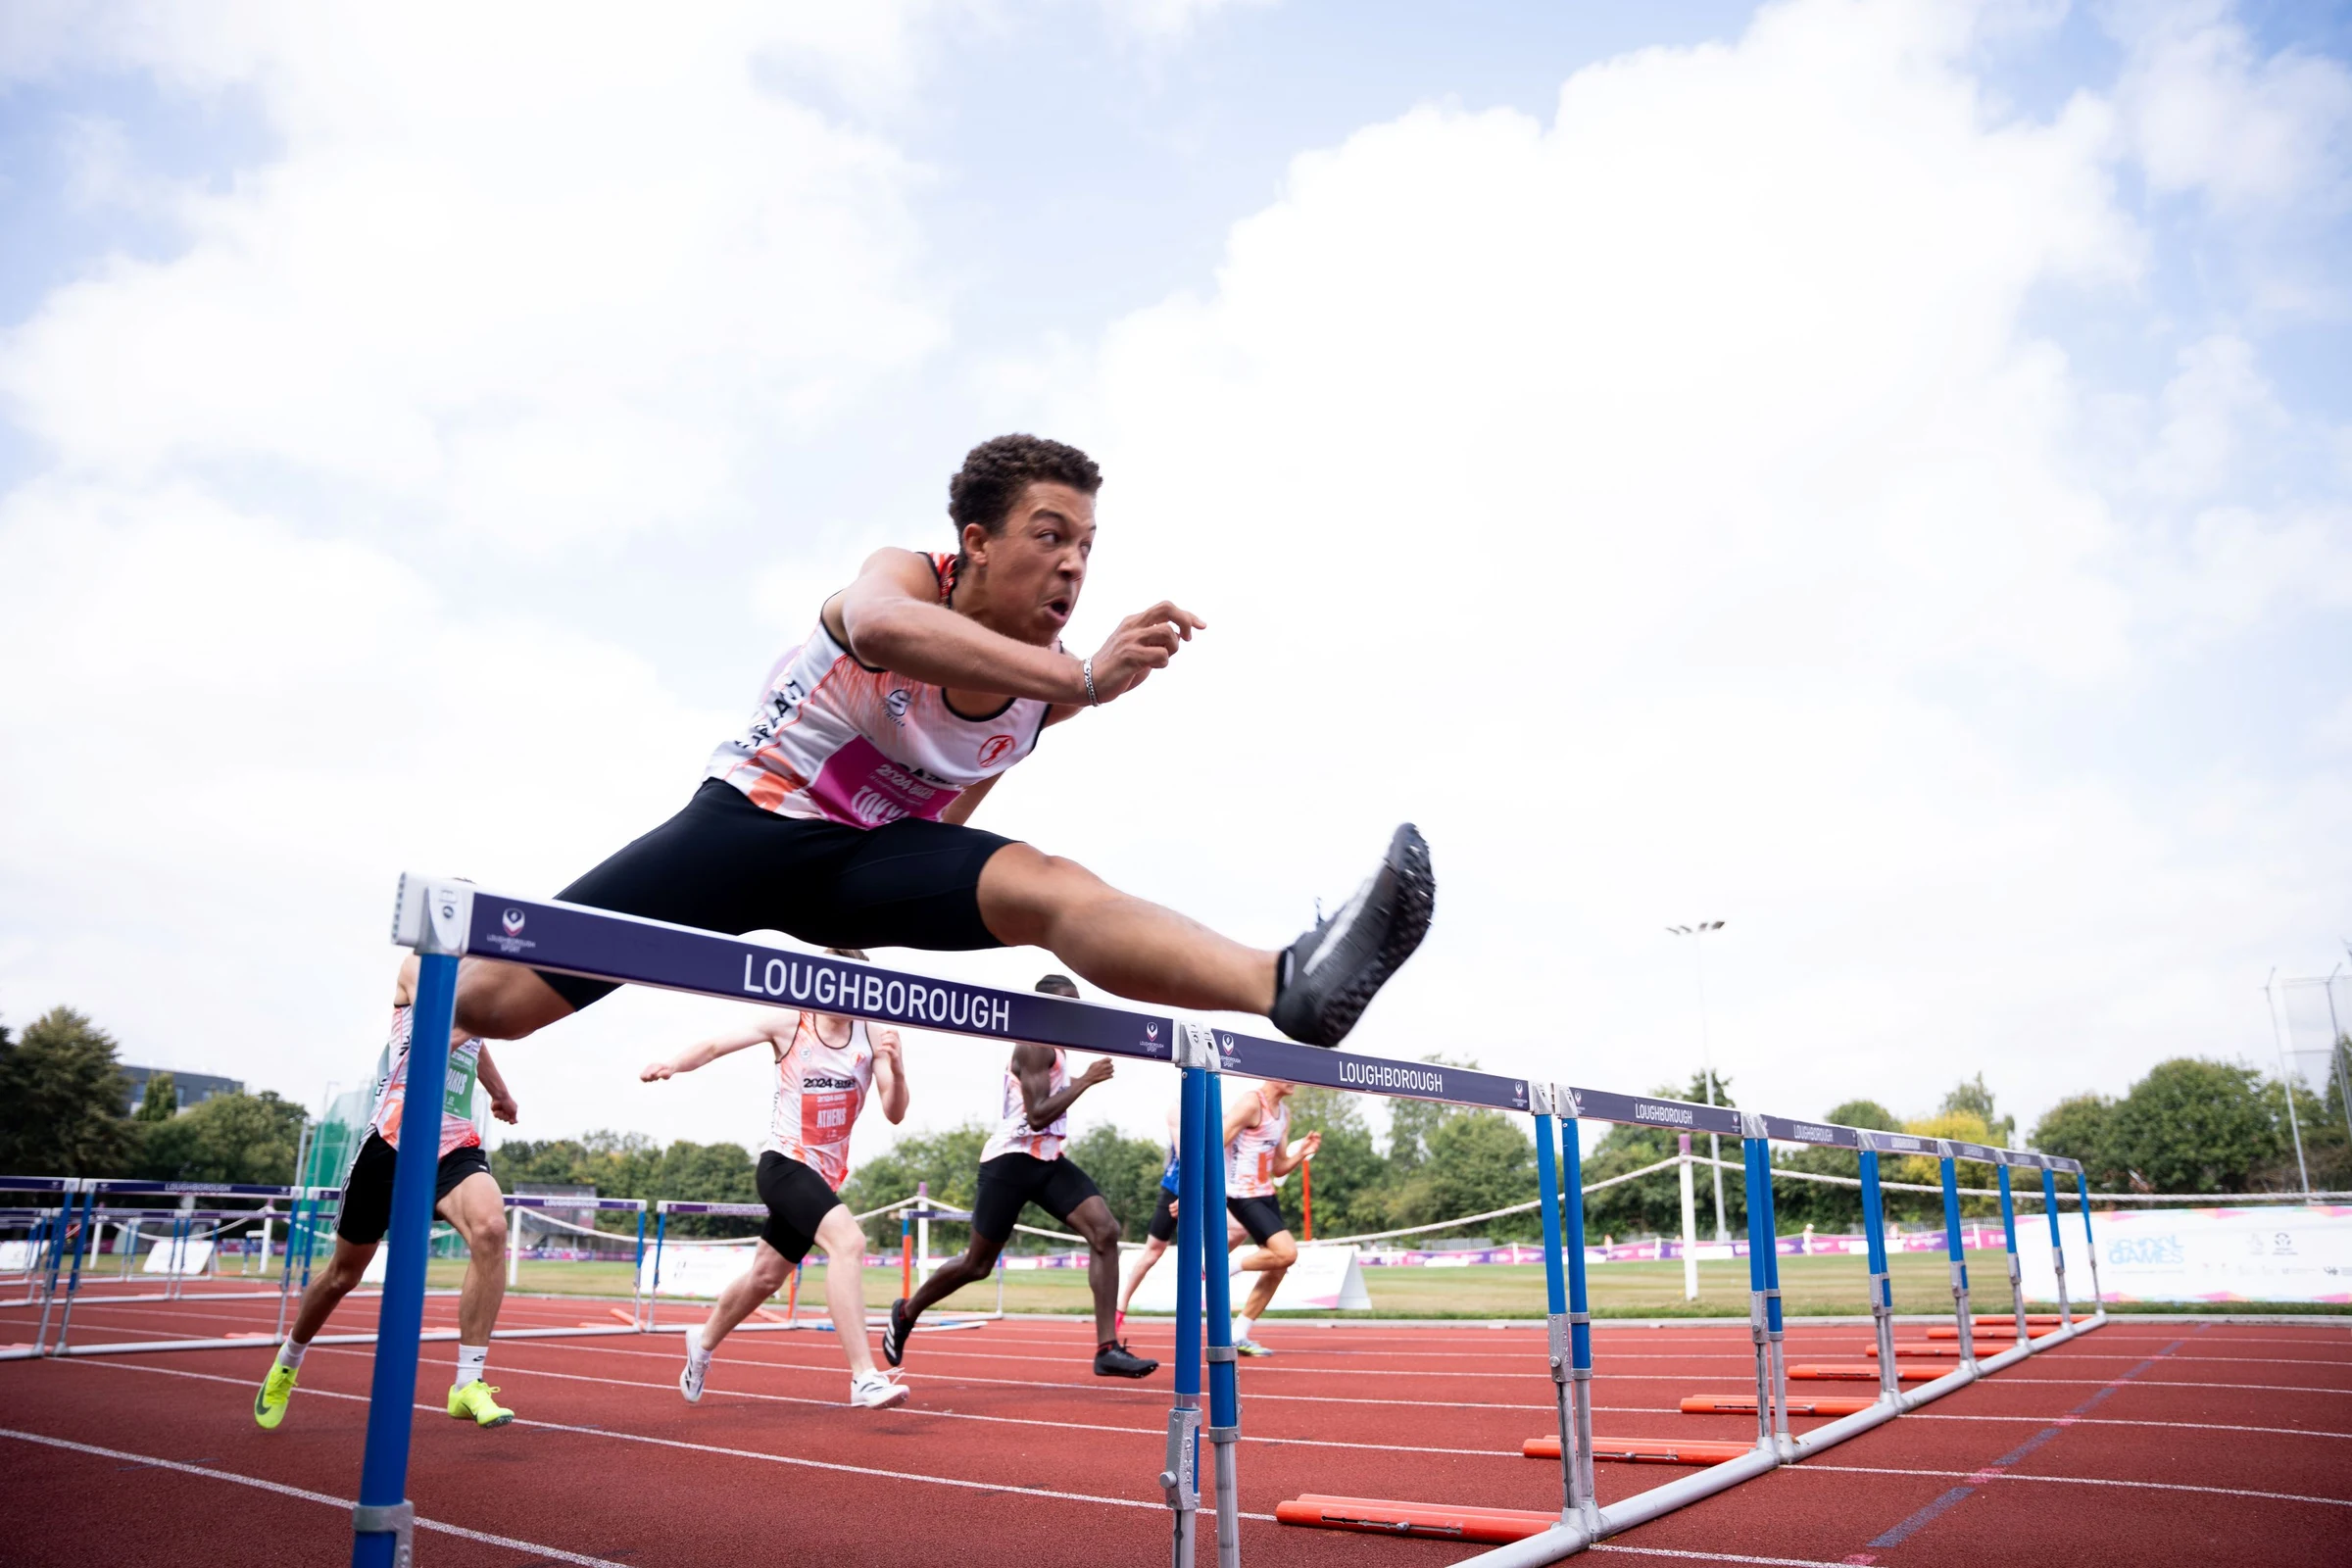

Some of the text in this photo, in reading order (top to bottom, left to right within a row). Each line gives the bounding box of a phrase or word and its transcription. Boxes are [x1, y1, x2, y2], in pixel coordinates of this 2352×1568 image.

[744, 954, 1009, 1032] LOUGHBOROUGH
[804, 1078, 833, 1088] 2024
[1339, 1061, 1443, 1093] LOUGHBOROUGH
[1635, 1103, 1693, 1125] LOUGHBOROUGH
